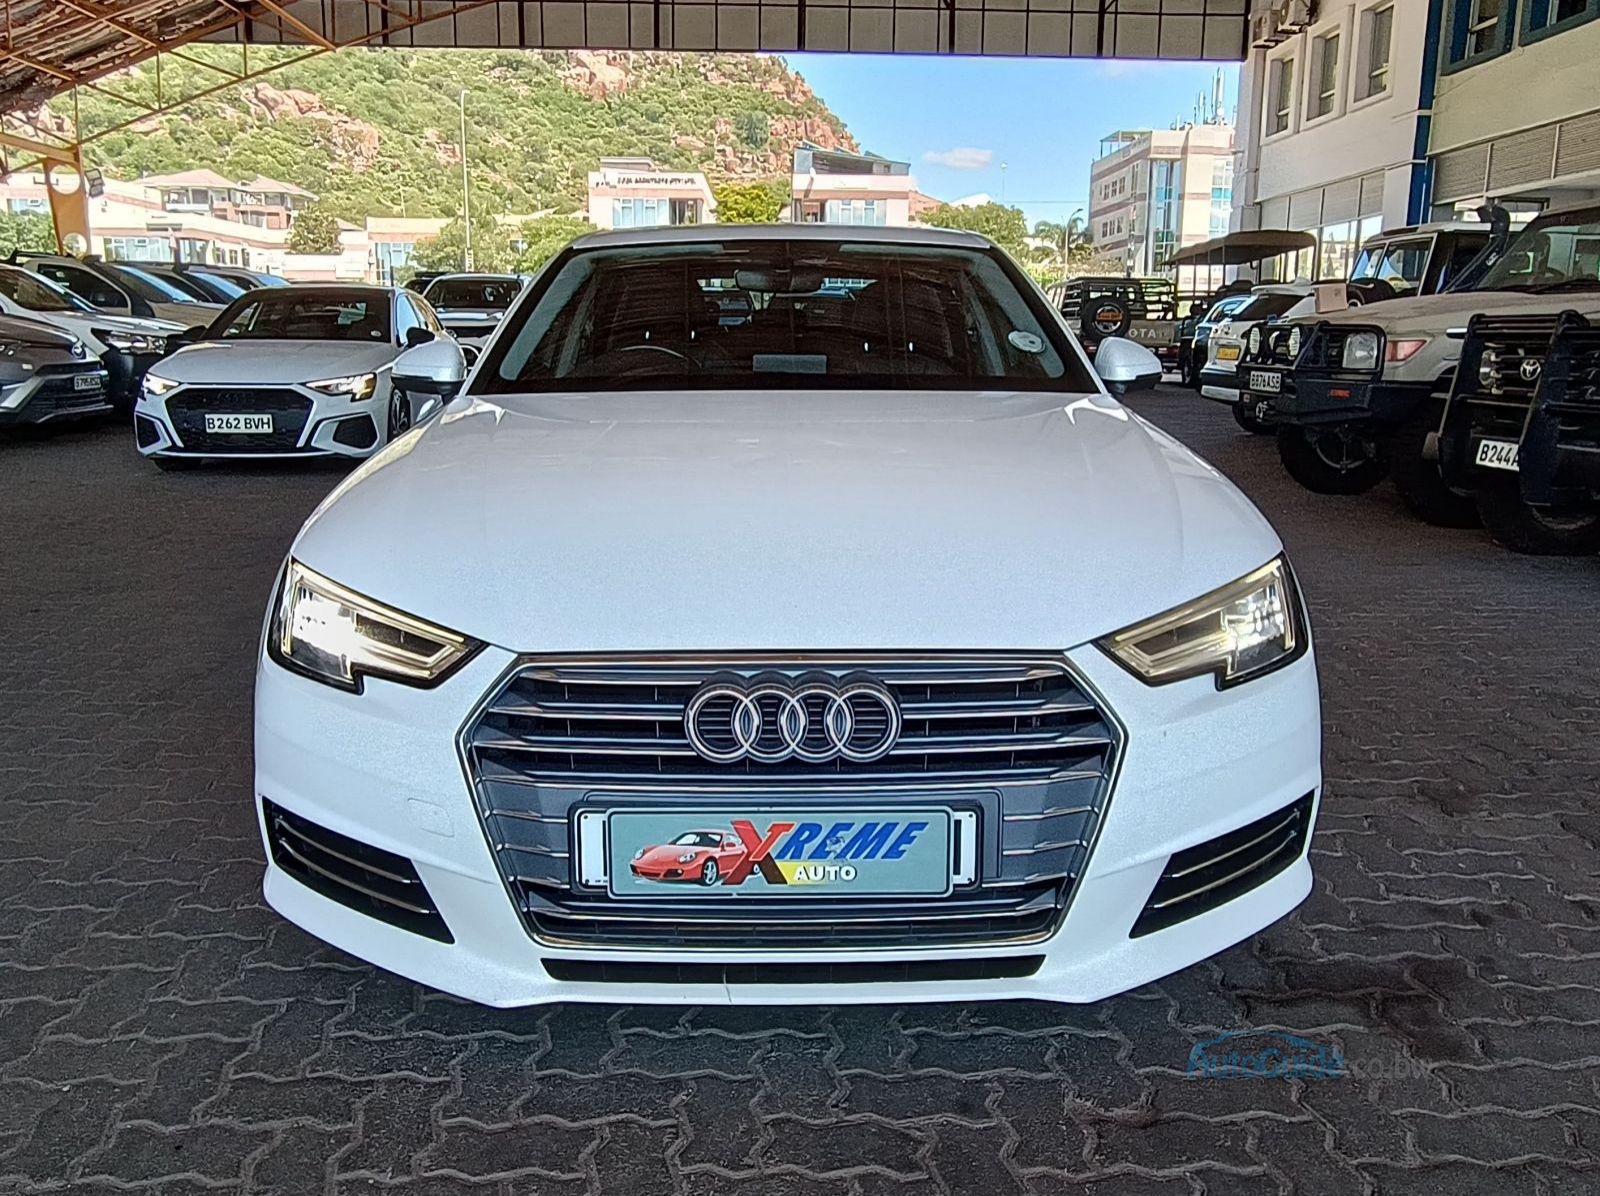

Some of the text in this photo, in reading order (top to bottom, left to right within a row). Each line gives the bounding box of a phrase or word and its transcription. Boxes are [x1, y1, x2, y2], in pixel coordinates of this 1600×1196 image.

[1128, 328, 1157, 338] OTA
[207, 417, 271, 429] B262 BVH
[794, 865, 858, 882] AUTO
